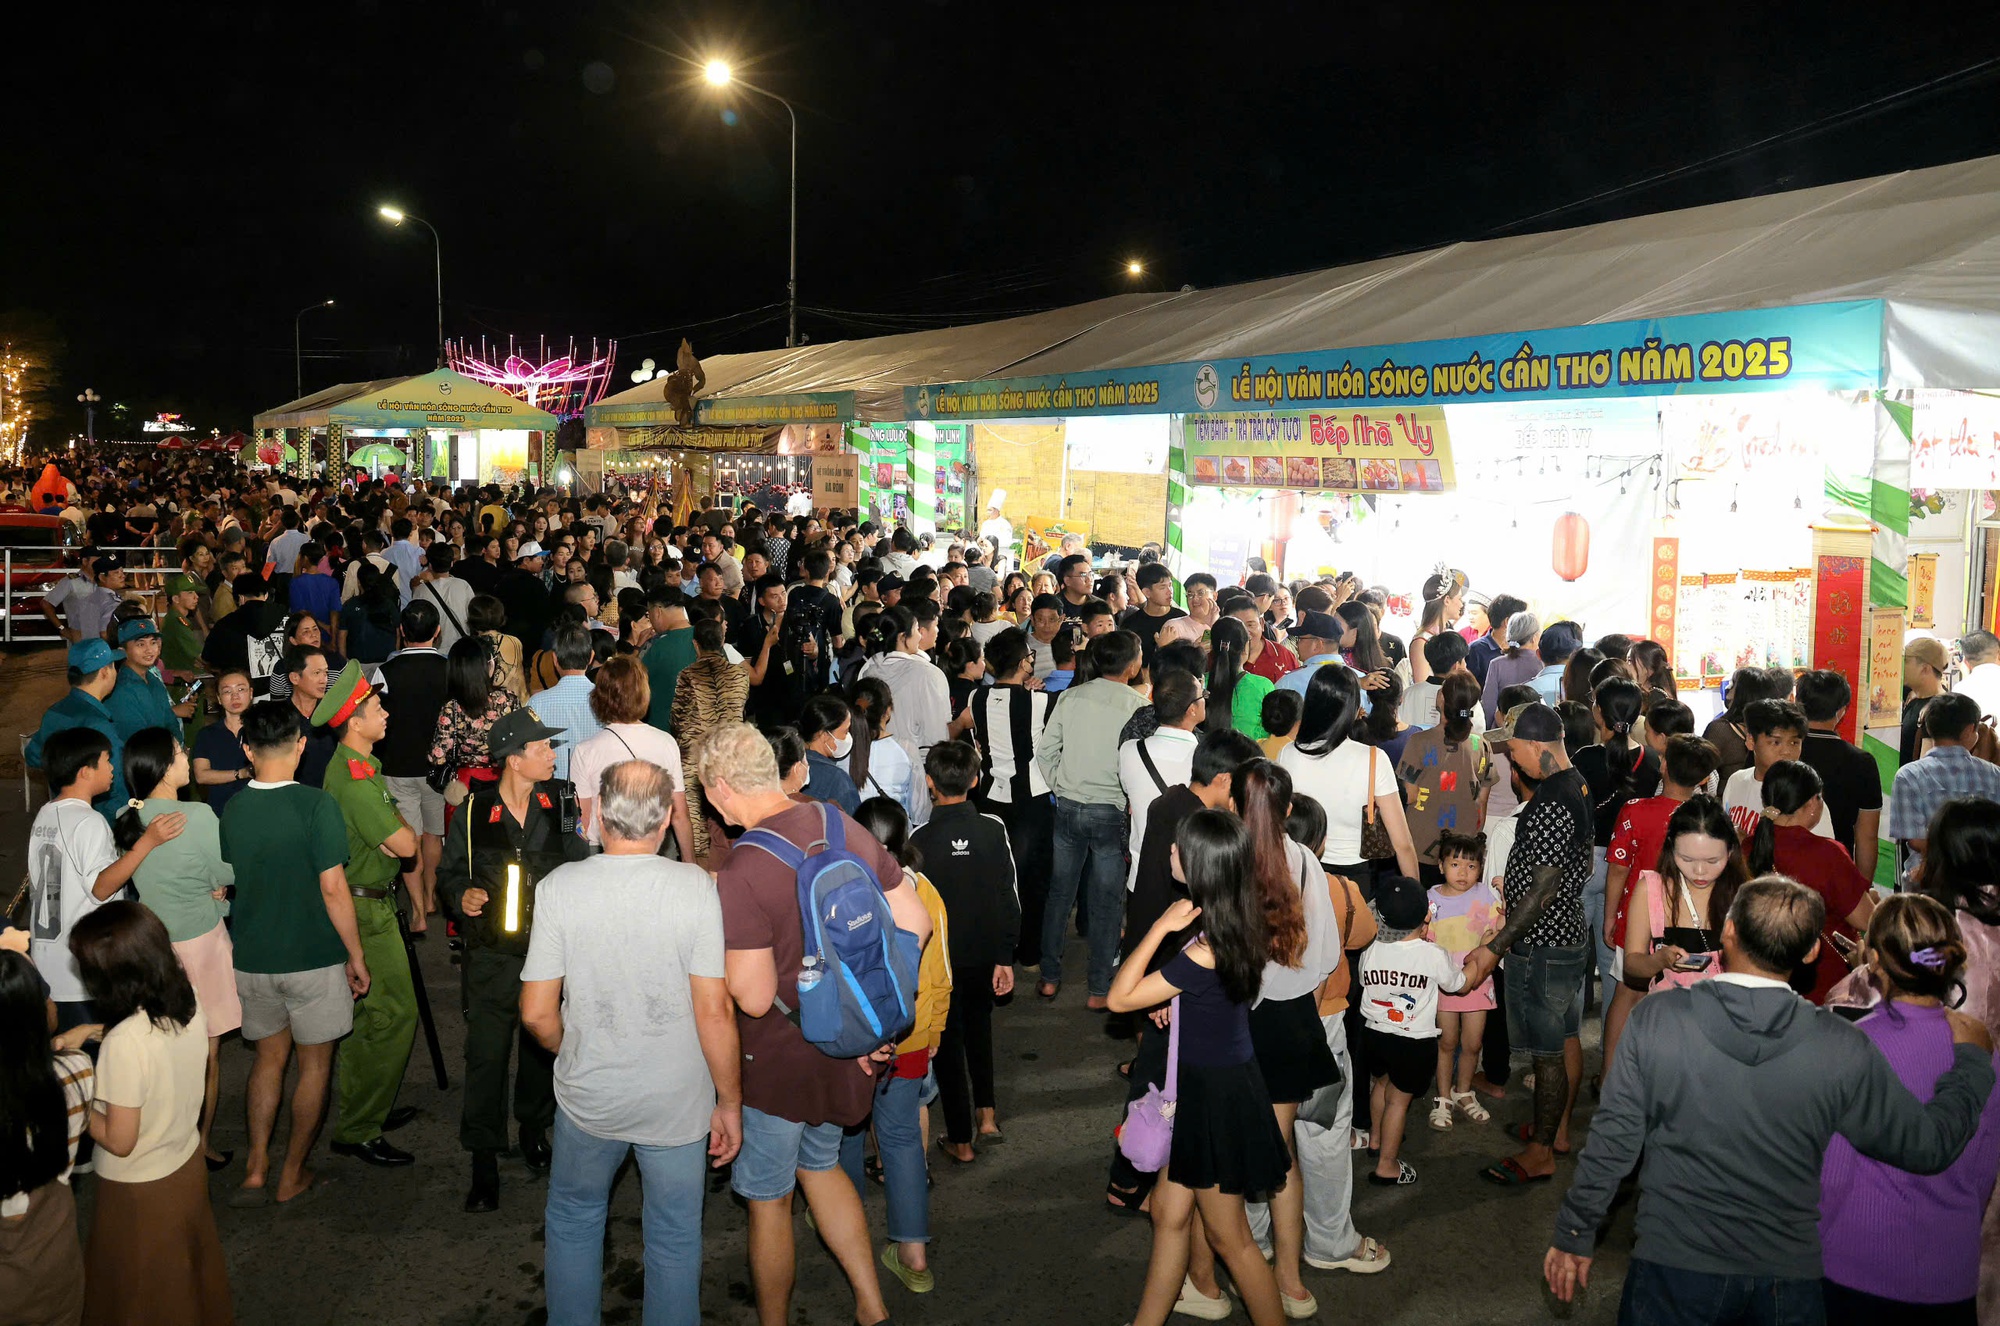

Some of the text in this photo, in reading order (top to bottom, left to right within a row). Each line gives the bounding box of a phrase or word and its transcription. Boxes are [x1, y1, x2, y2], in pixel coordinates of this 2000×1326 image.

[1232, 337, 1791, 407] LỄ HỘI VĂN HÓA SÔNG NƯỚC CẦN THƠ NĂM 2025
[438, 402, 459, 412] SÔNG
[820, 403, 837, 418] 2025
[946, 390, 960, 417] HỘI
[962, 391, 978, 413] VĂN
[980, 388, 997, 411] HÓA
[999, 386, 1024, 411] SÔNG
[1026, 383, 1051, 411] NƯỚC
[1053, 379, 1073, 409] CẦN
[1075, 387, 1096, 407] THƠ
[1099, 381, 1126, 406] NĂM
[1128, 382, 1159, 404] 2025
[1309, 413, 1435, 456] Bếp Nhà Vy
[1363, 969, 1429, 990] HOUSTON
